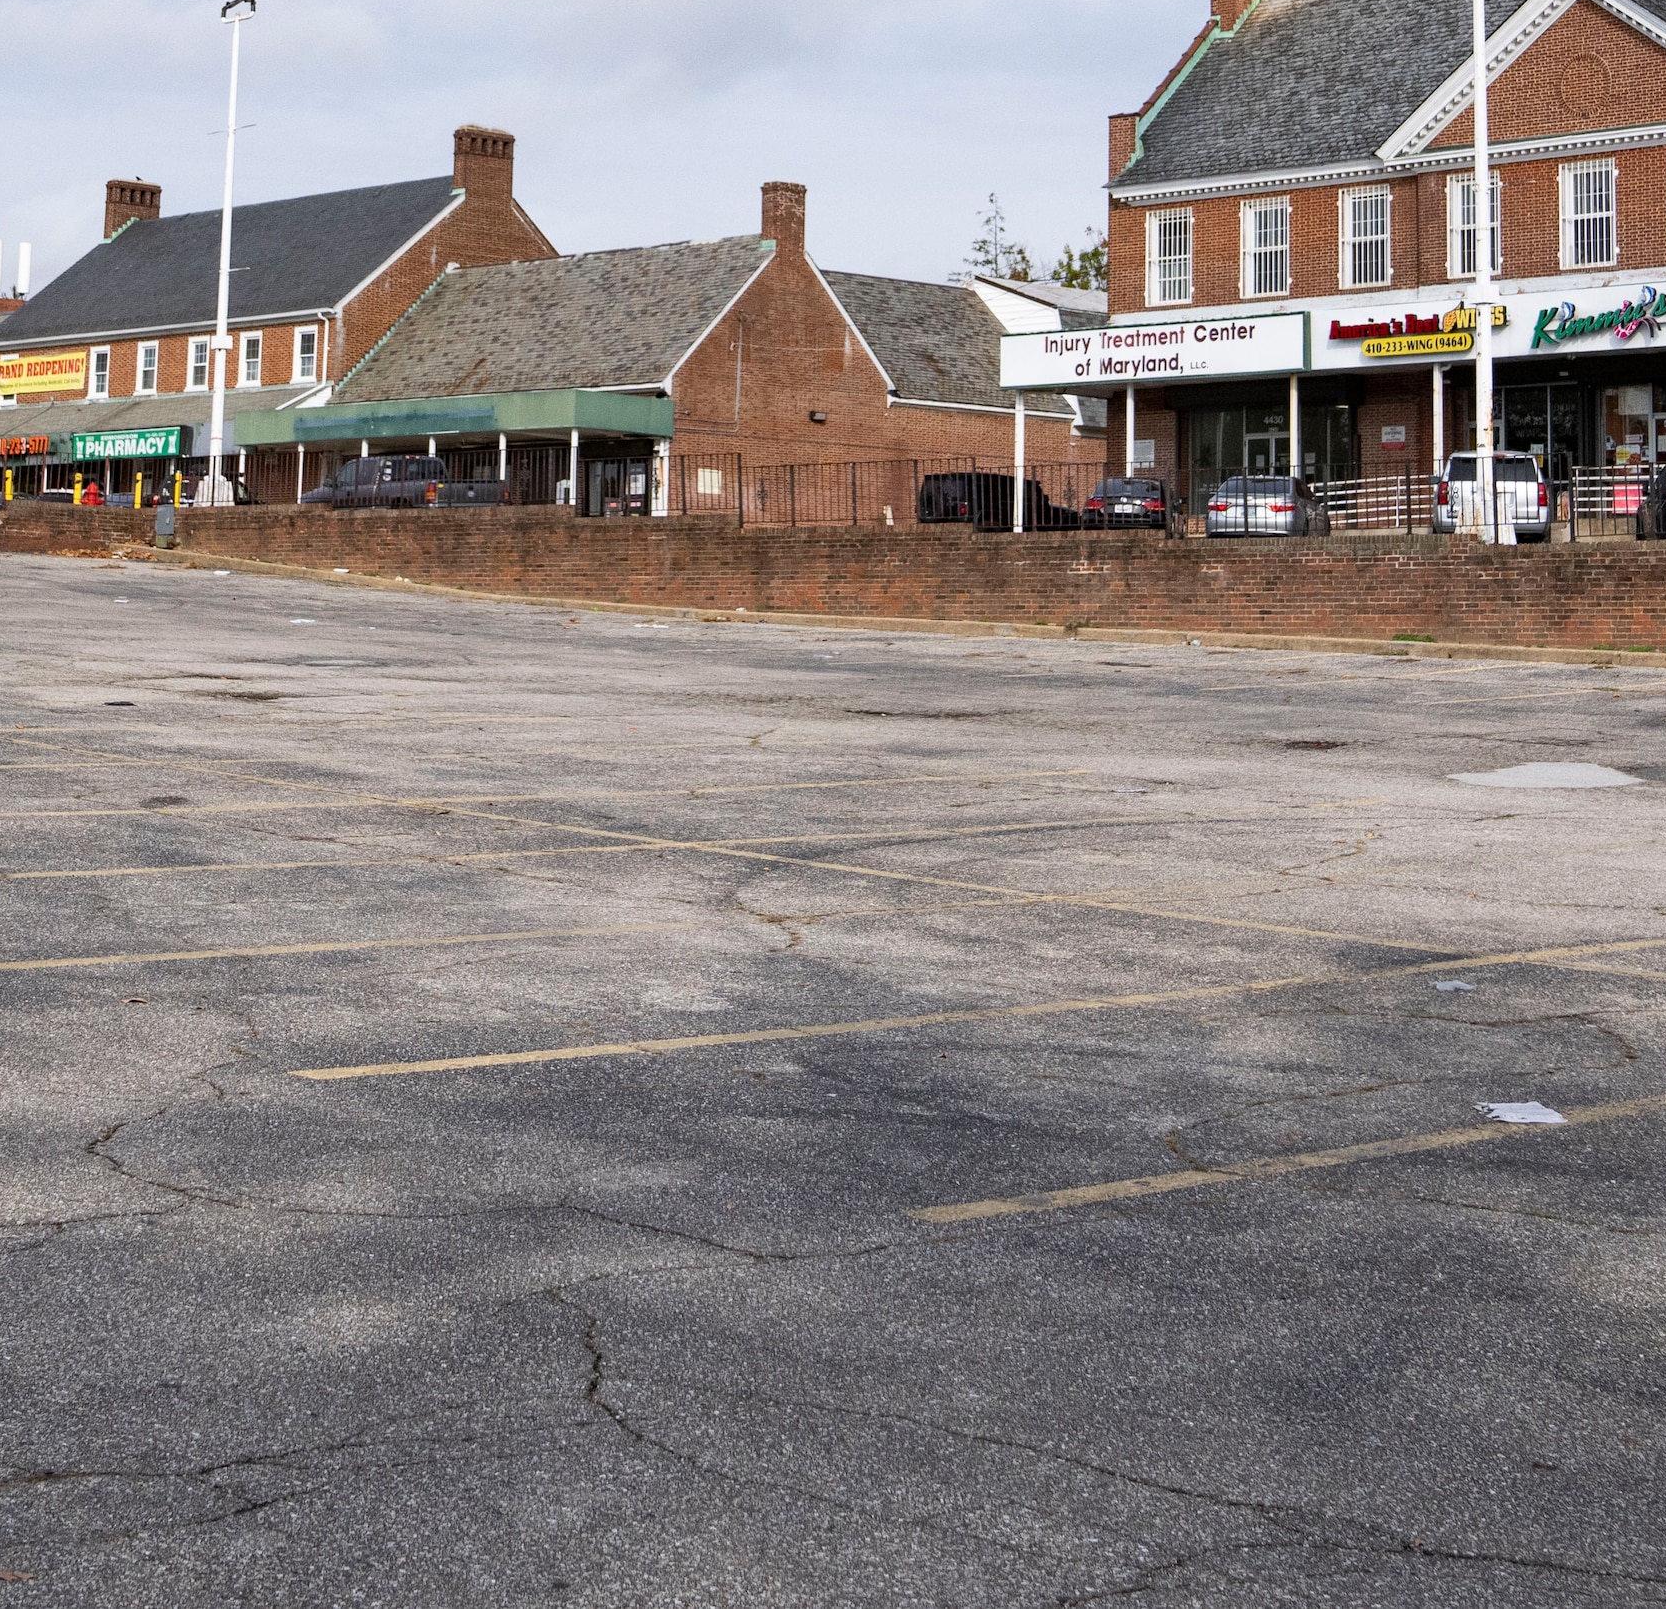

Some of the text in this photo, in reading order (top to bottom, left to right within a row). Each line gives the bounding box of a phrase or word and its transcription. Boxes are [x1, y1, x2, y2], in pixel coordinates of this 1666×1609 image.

[1329, 306, 1506, 340] America's Best WIS
[1044, 323, 1256, 355] Injury Treatment Center
[1365, 335, 1467, 353] 410-233-WING (9464)
[26, 358, 84, 378] REOPENING!
[1075, 358, 1092, 377] of
[1099, 353, 1184, 377] Maryland,
[1263, 415, 1284, 425] 4430
[85, 437, 166, 458] PHARMACY
